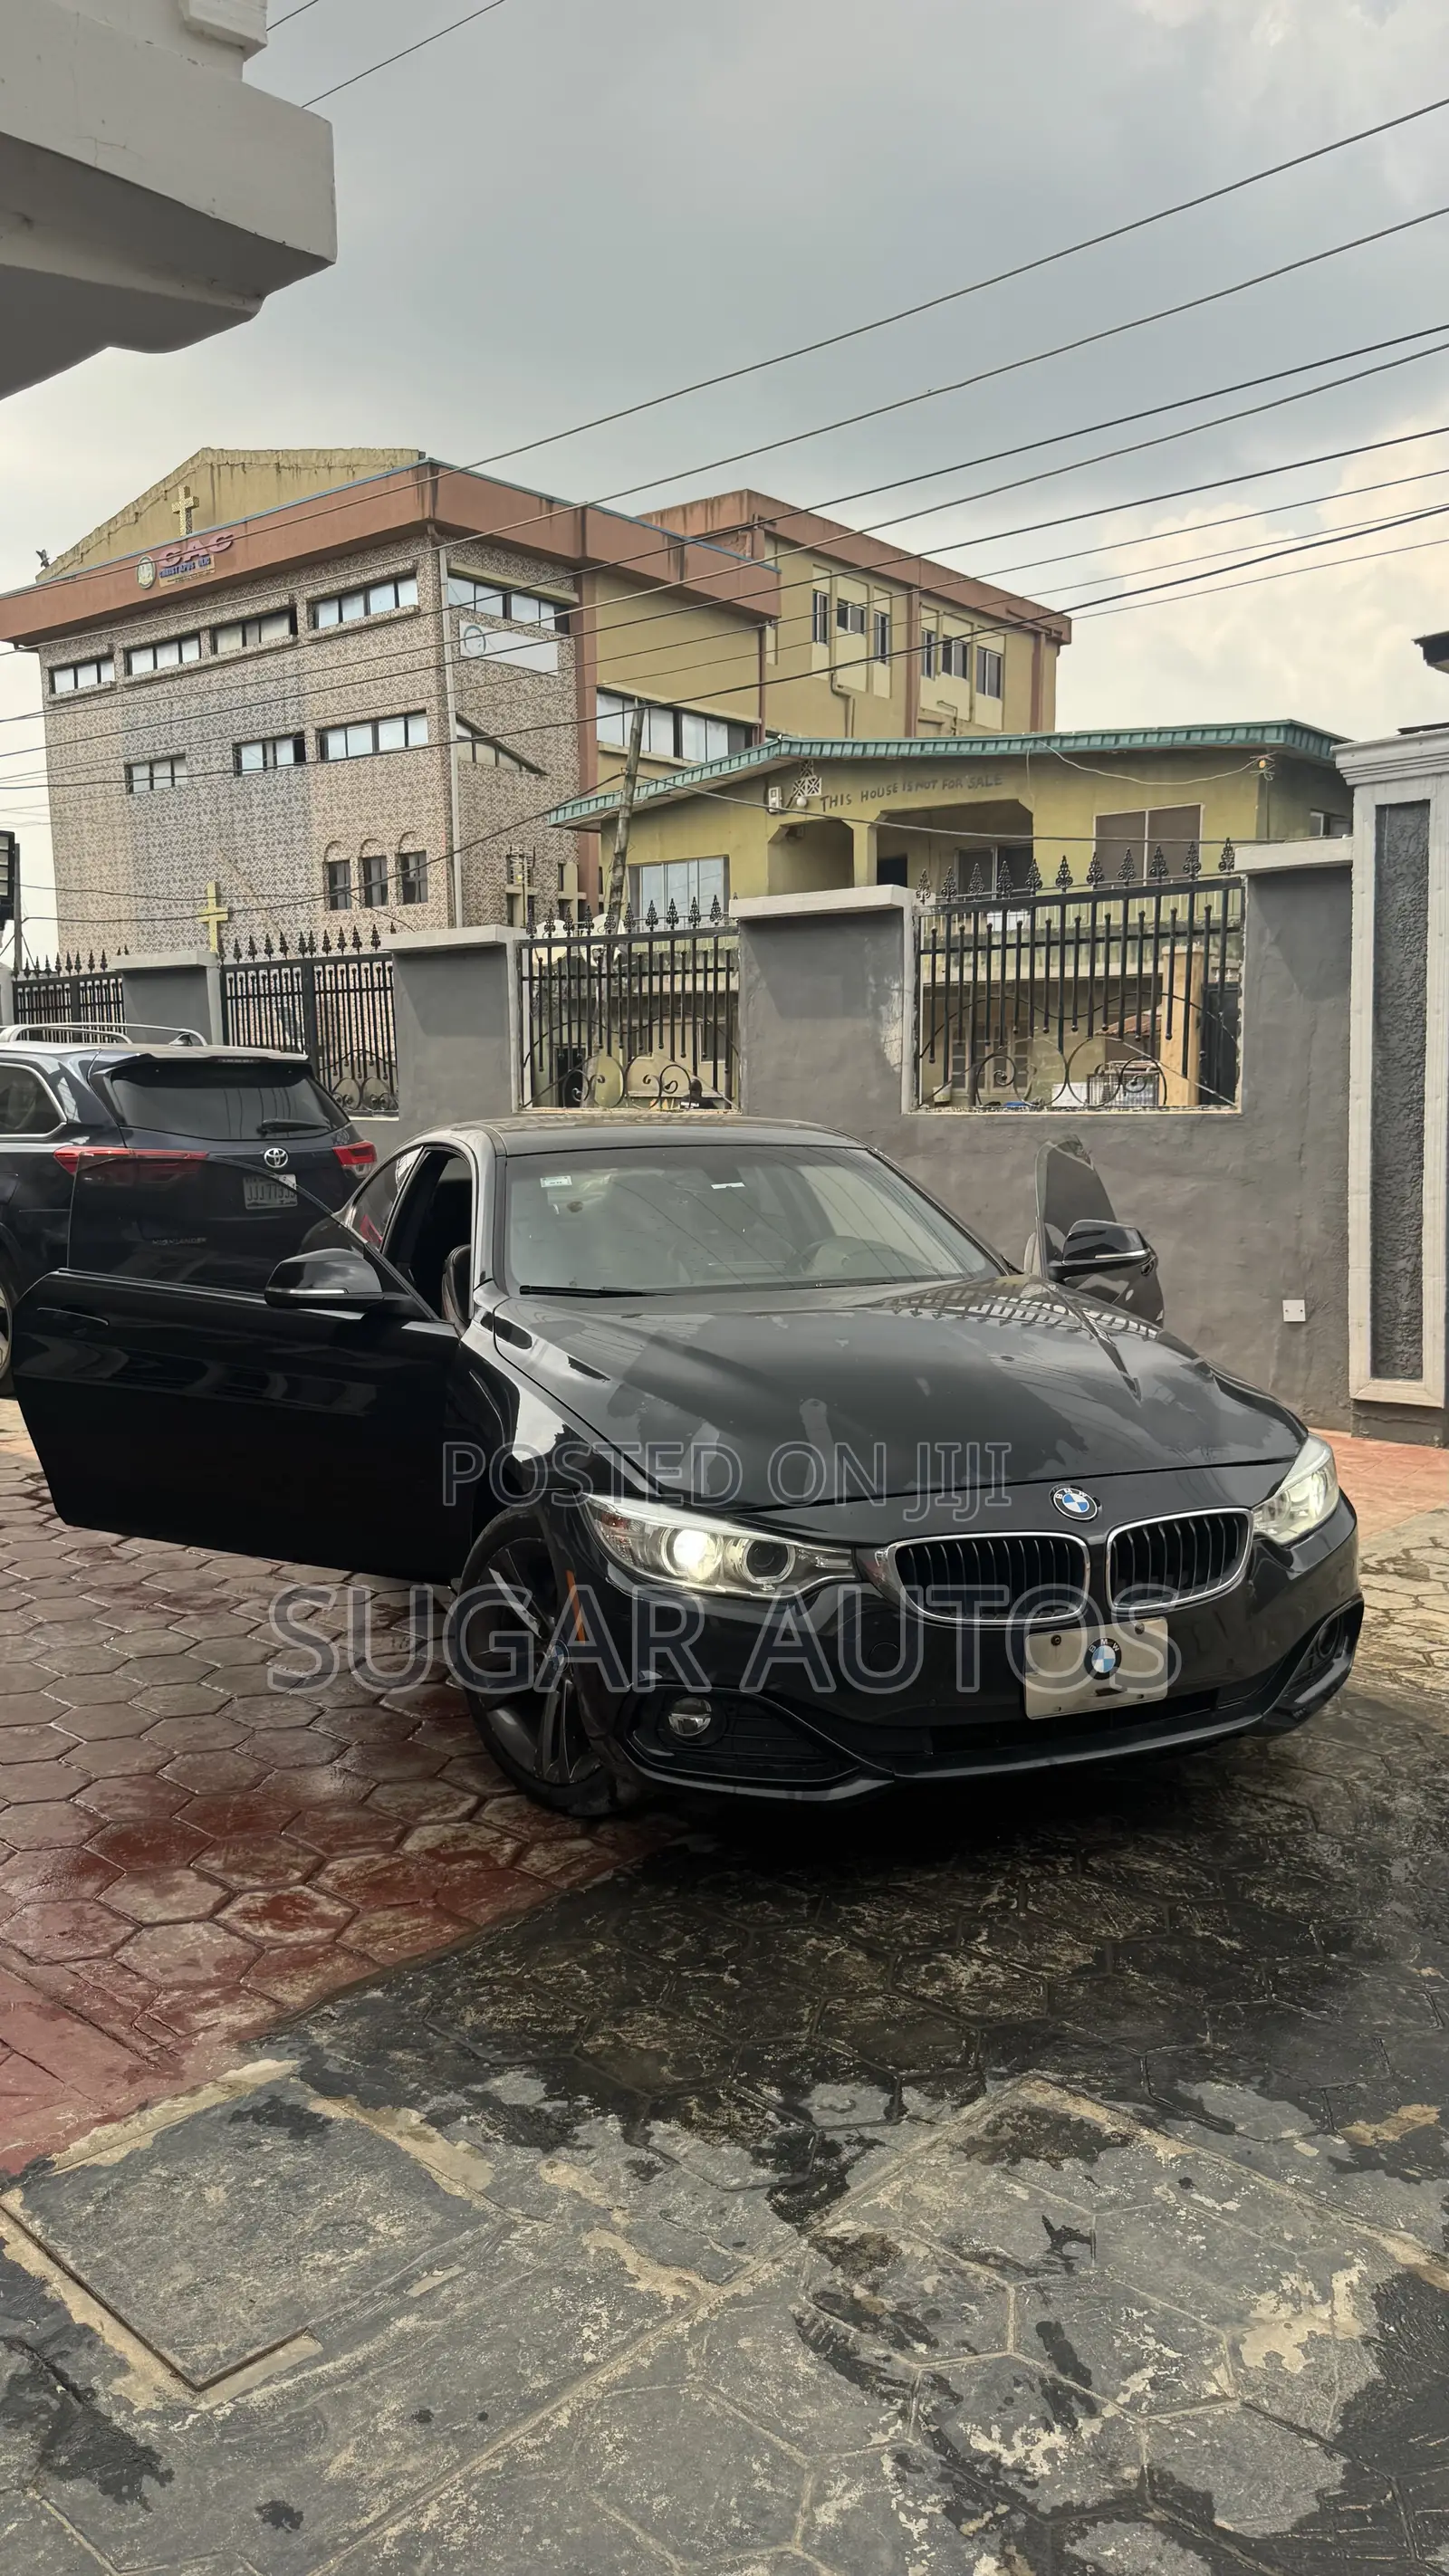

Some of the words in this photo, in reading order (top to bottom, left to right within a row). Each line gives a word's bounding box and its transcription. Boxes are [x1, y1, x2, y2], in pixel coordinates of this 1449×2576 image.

[820, 793, 852, 812] THIS
[861, 783, 898, 802] HOUSE
[902, 780, 913, 792] IS
[915, 779, 938, 791] NOT
[942, 778, 964, 790] FOR
[967, 775, 1003, 790] SALE
[1055, 1488, 1088, 1499] BMW
[1089, 1639, 1119, 1652] BMW
